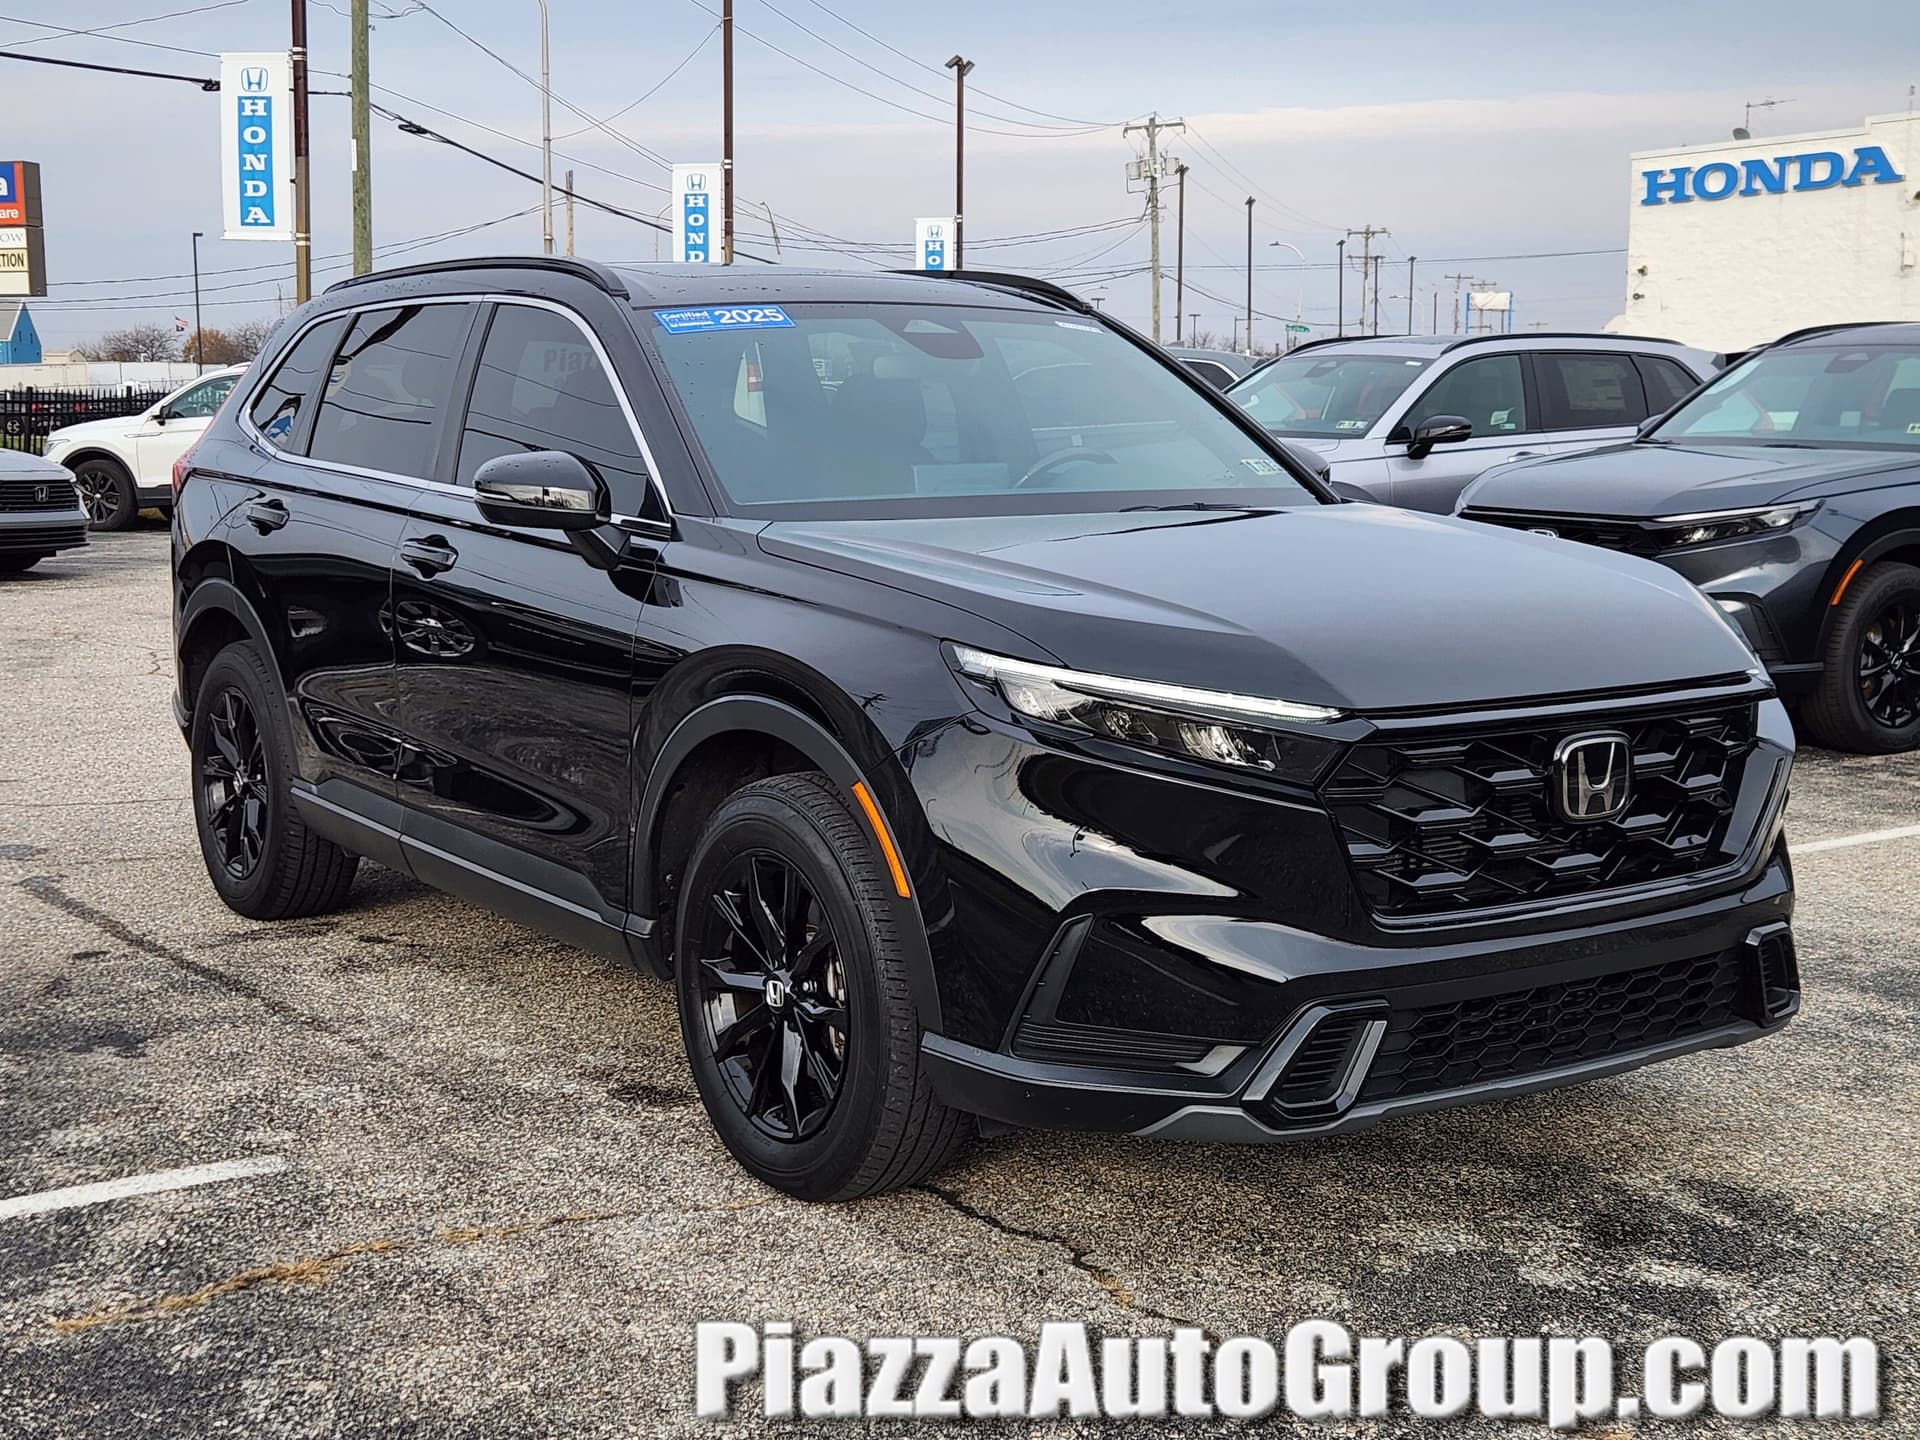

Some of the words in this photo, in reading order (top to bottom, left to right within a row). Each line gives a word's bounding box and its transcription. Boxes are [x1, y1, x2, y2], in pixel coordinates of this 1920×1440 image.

[241, 99, 271, 224] HONDA
[1641, 146, 1905, 206] HONDA
[687, 196, 706, 262] HOND
[0, 254, 25, 268] TION
[928, 242, 941, 266] HO
[714, 308, 784, 324] 2025
[543, 347, 602, 374] Piaz
